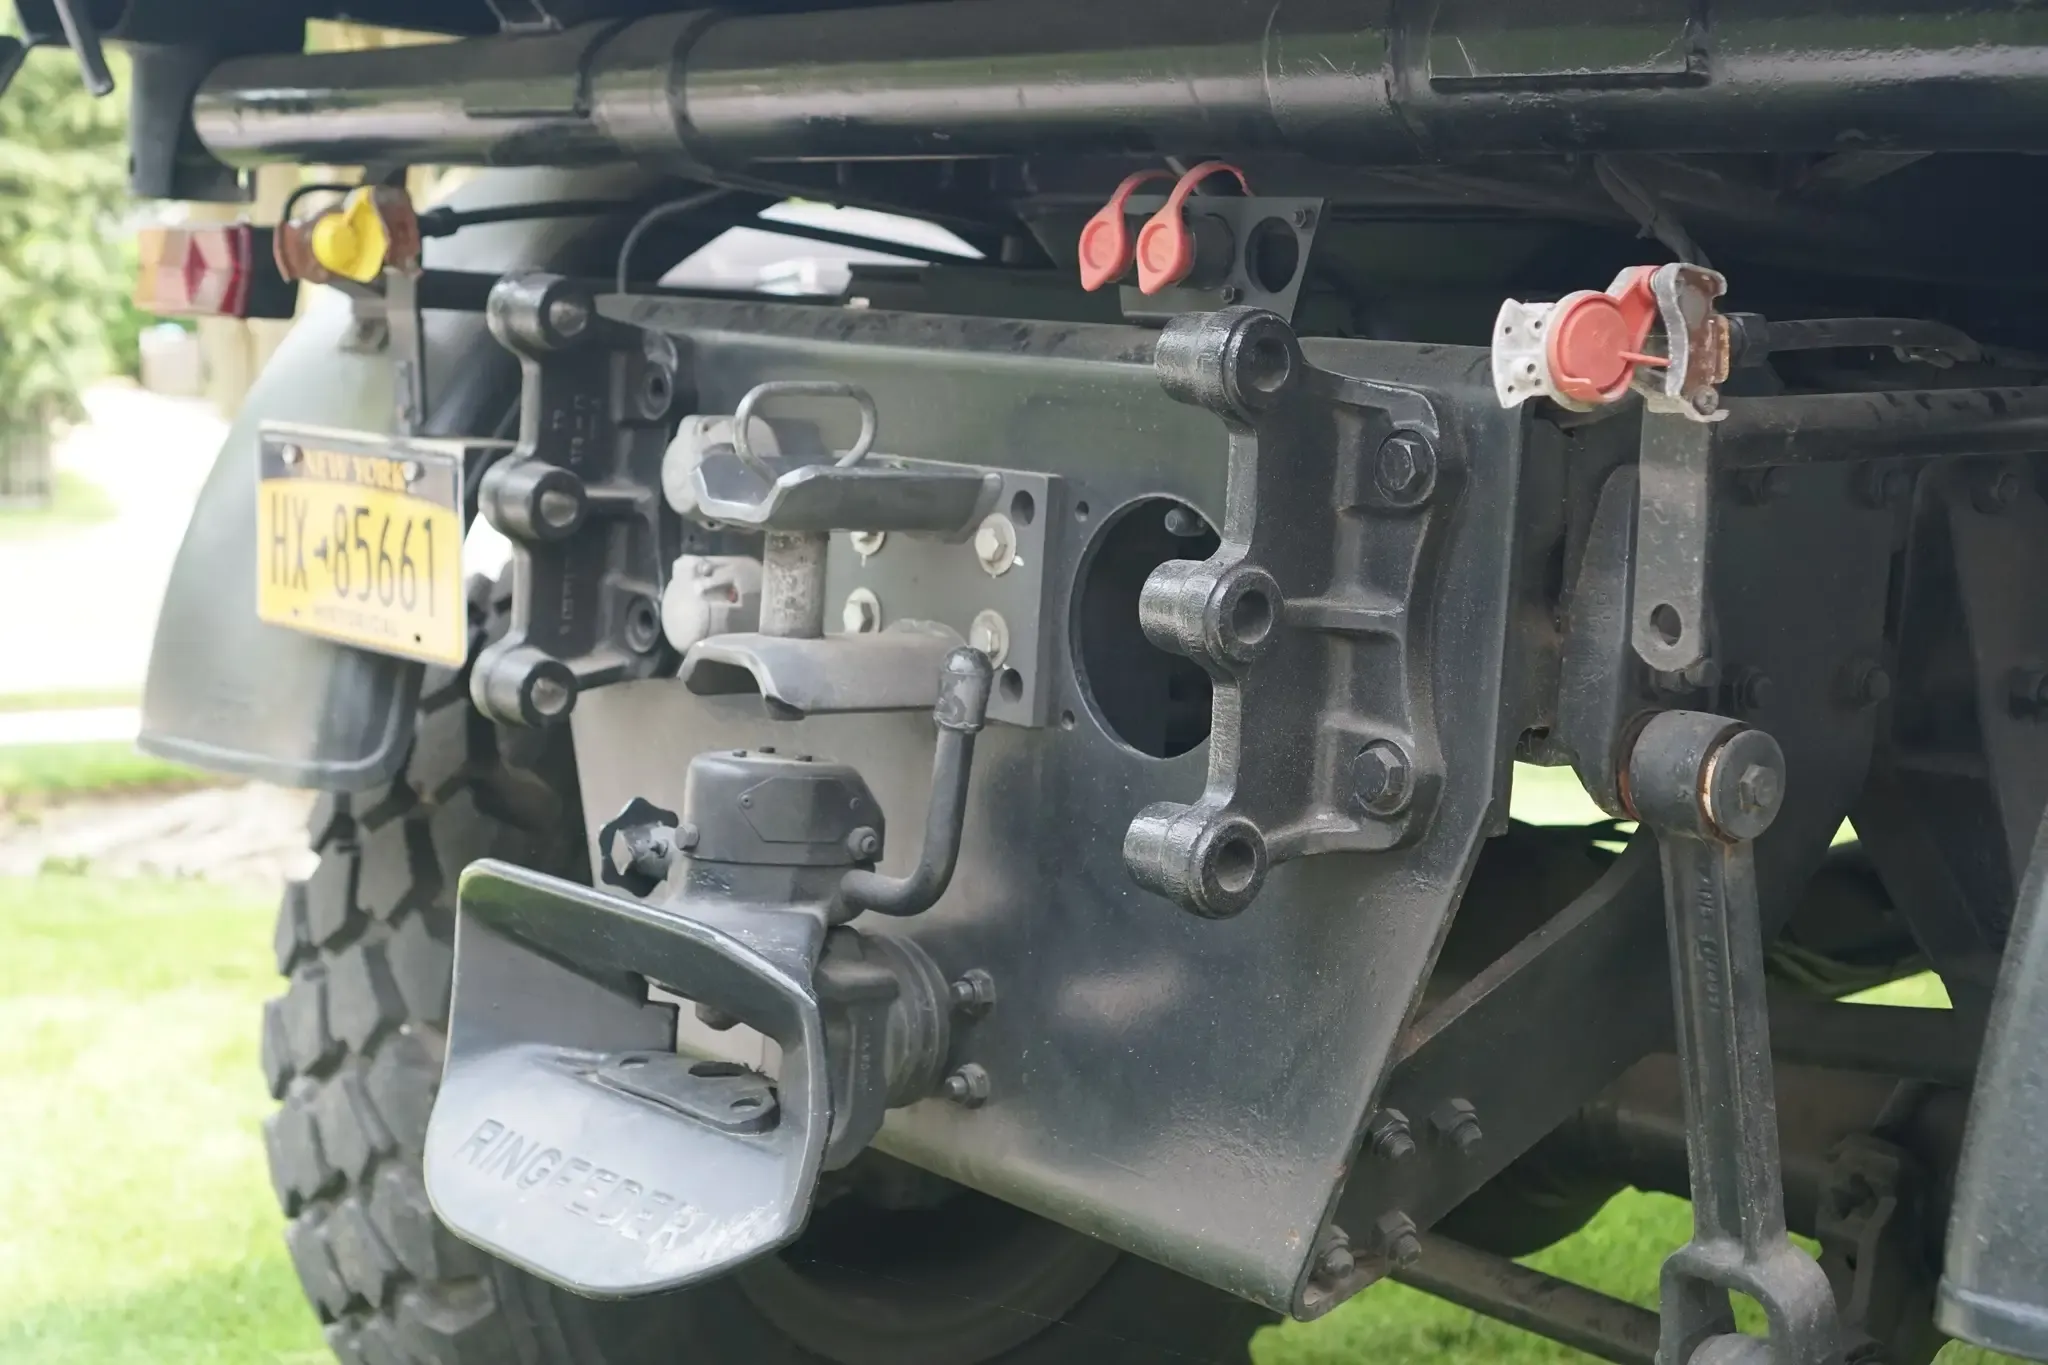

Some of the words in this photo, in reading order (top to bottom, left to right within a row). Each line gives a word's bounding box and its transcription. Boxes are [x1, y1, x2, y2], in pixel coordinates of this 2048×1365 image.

[304, 449, 349, 480] NEW
[353, 457, 405, 492] YORK
[271, 491, 309, 592] HX
[333, 503, 435, 617] 85661
[453, 1118, 697, 1250] RINGFEDER
